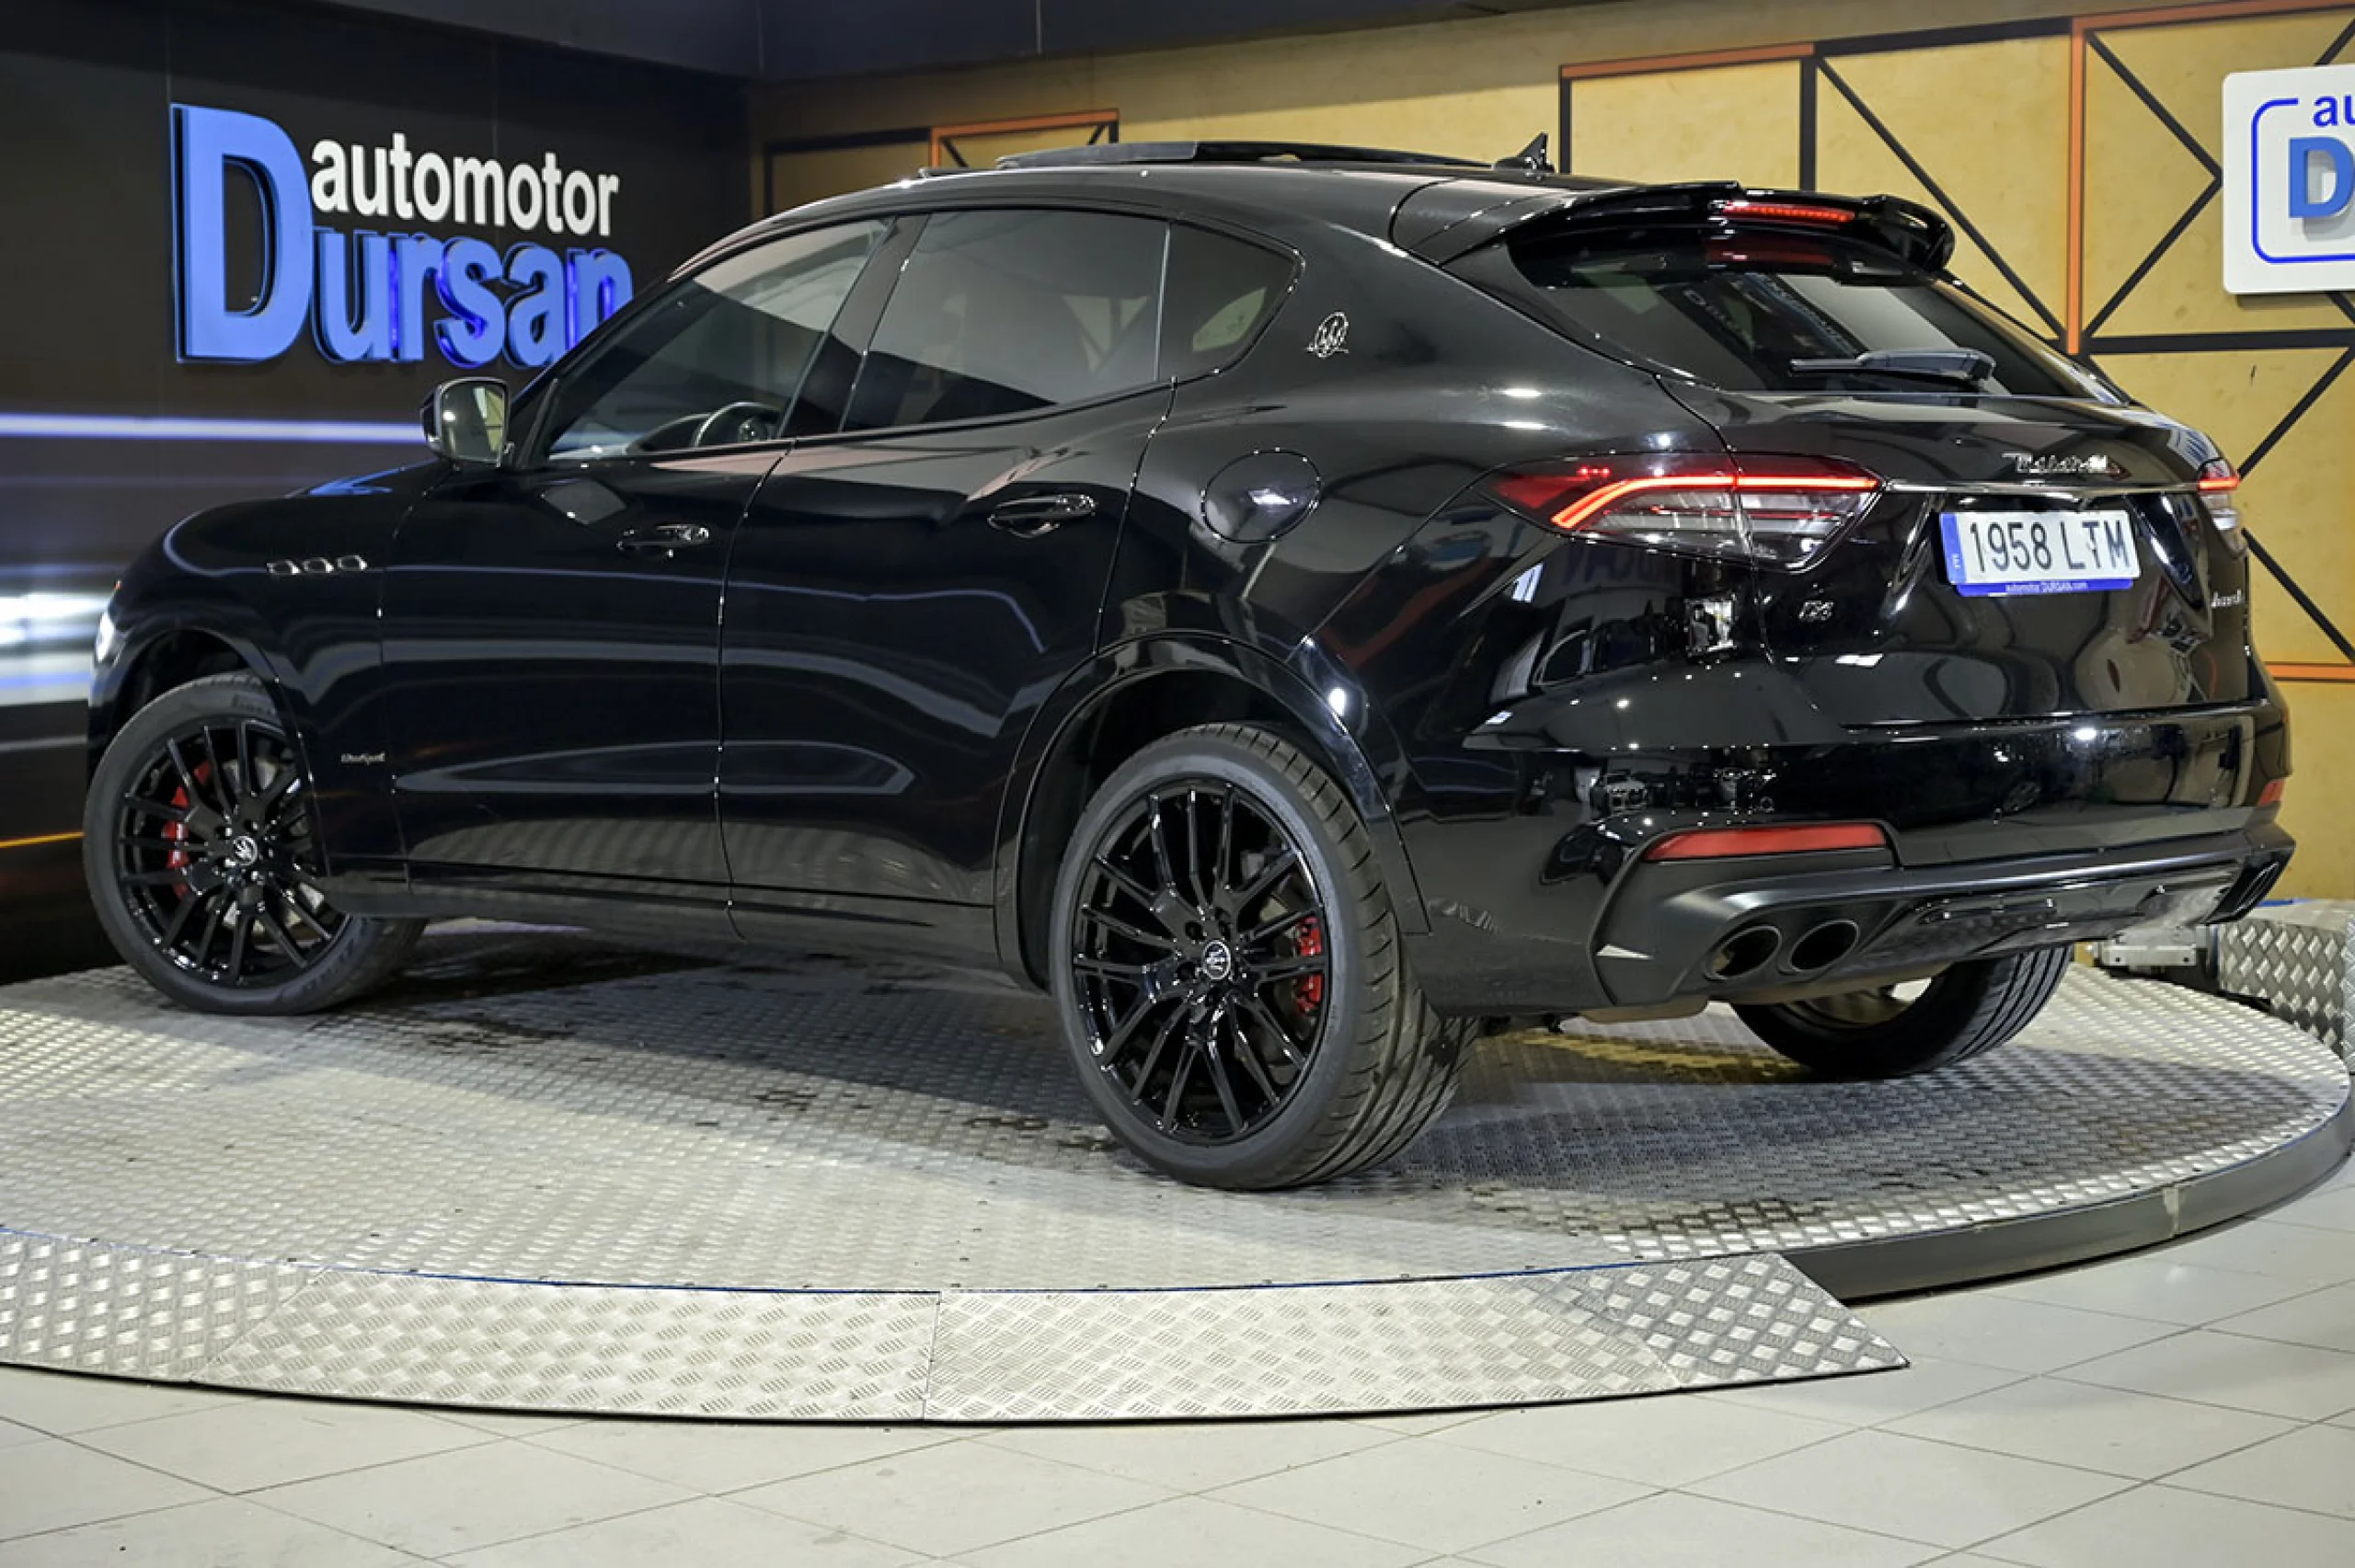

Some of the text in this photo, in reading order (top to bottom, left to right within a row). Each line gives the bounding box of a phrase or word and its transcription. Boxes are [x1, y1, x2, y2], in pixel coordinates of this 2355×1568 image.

[311, 132, 619, 236] automotor
[2288, 136, 2355, 219] D
[171, 103, 634, 368] Dursan
[1970, 519, 2131, 573] 1958 LTM
